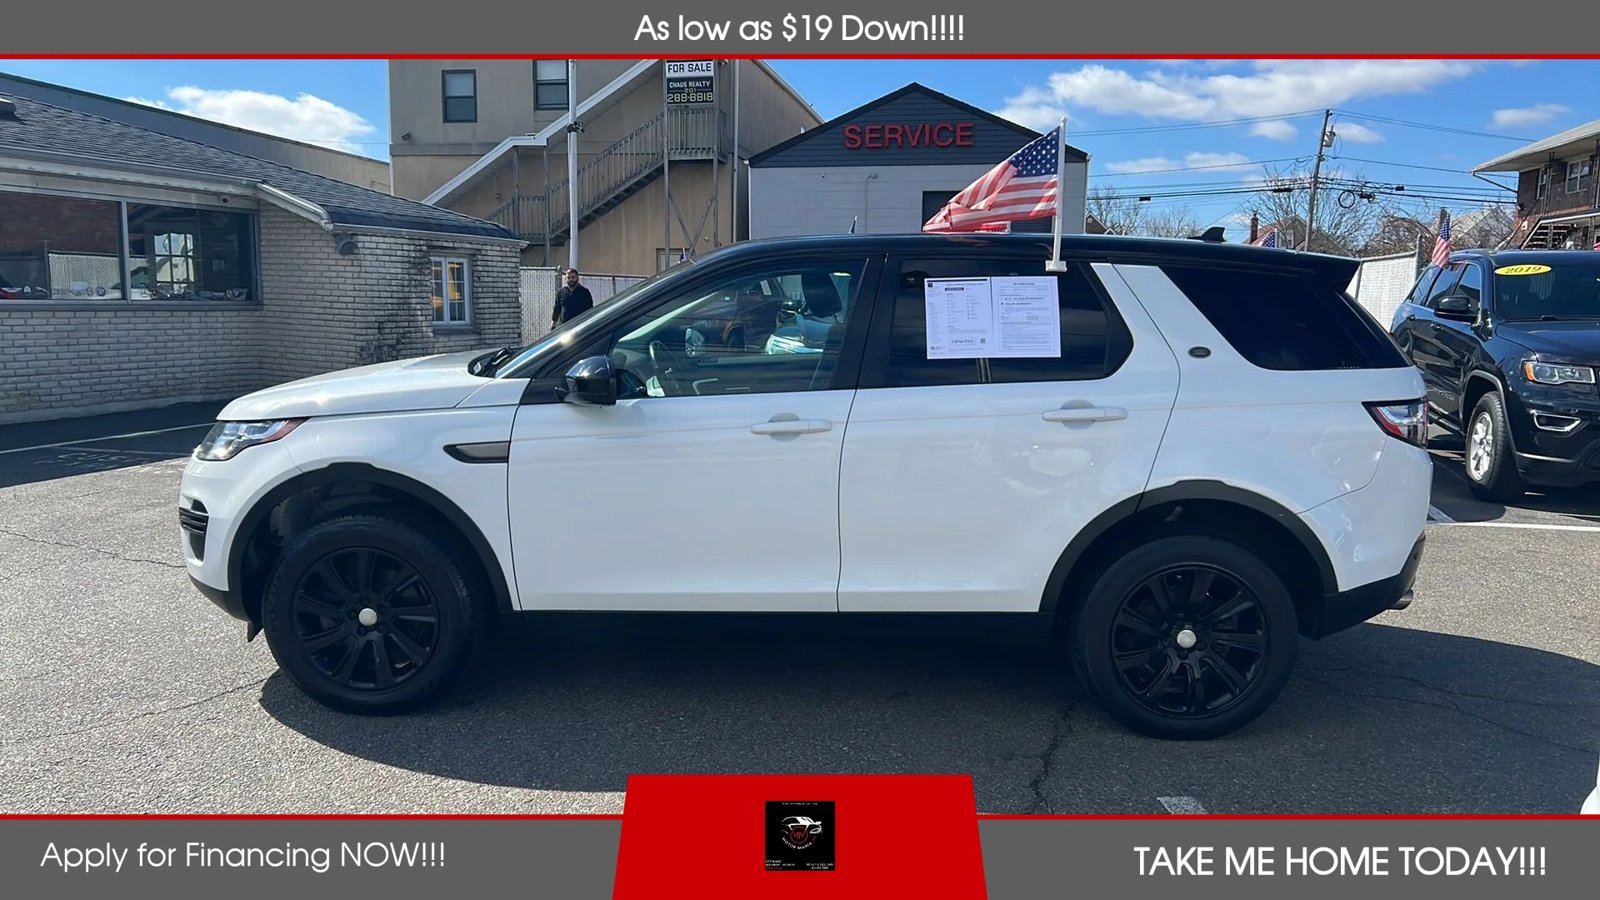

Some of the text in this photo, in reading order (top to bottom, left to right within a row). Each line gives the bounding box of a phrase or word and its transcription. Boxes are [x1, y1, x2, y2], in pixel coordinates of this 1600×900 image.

[668, 63, 711, 73] FOR SALE
[844, 122, 974, 149] SERVICE
